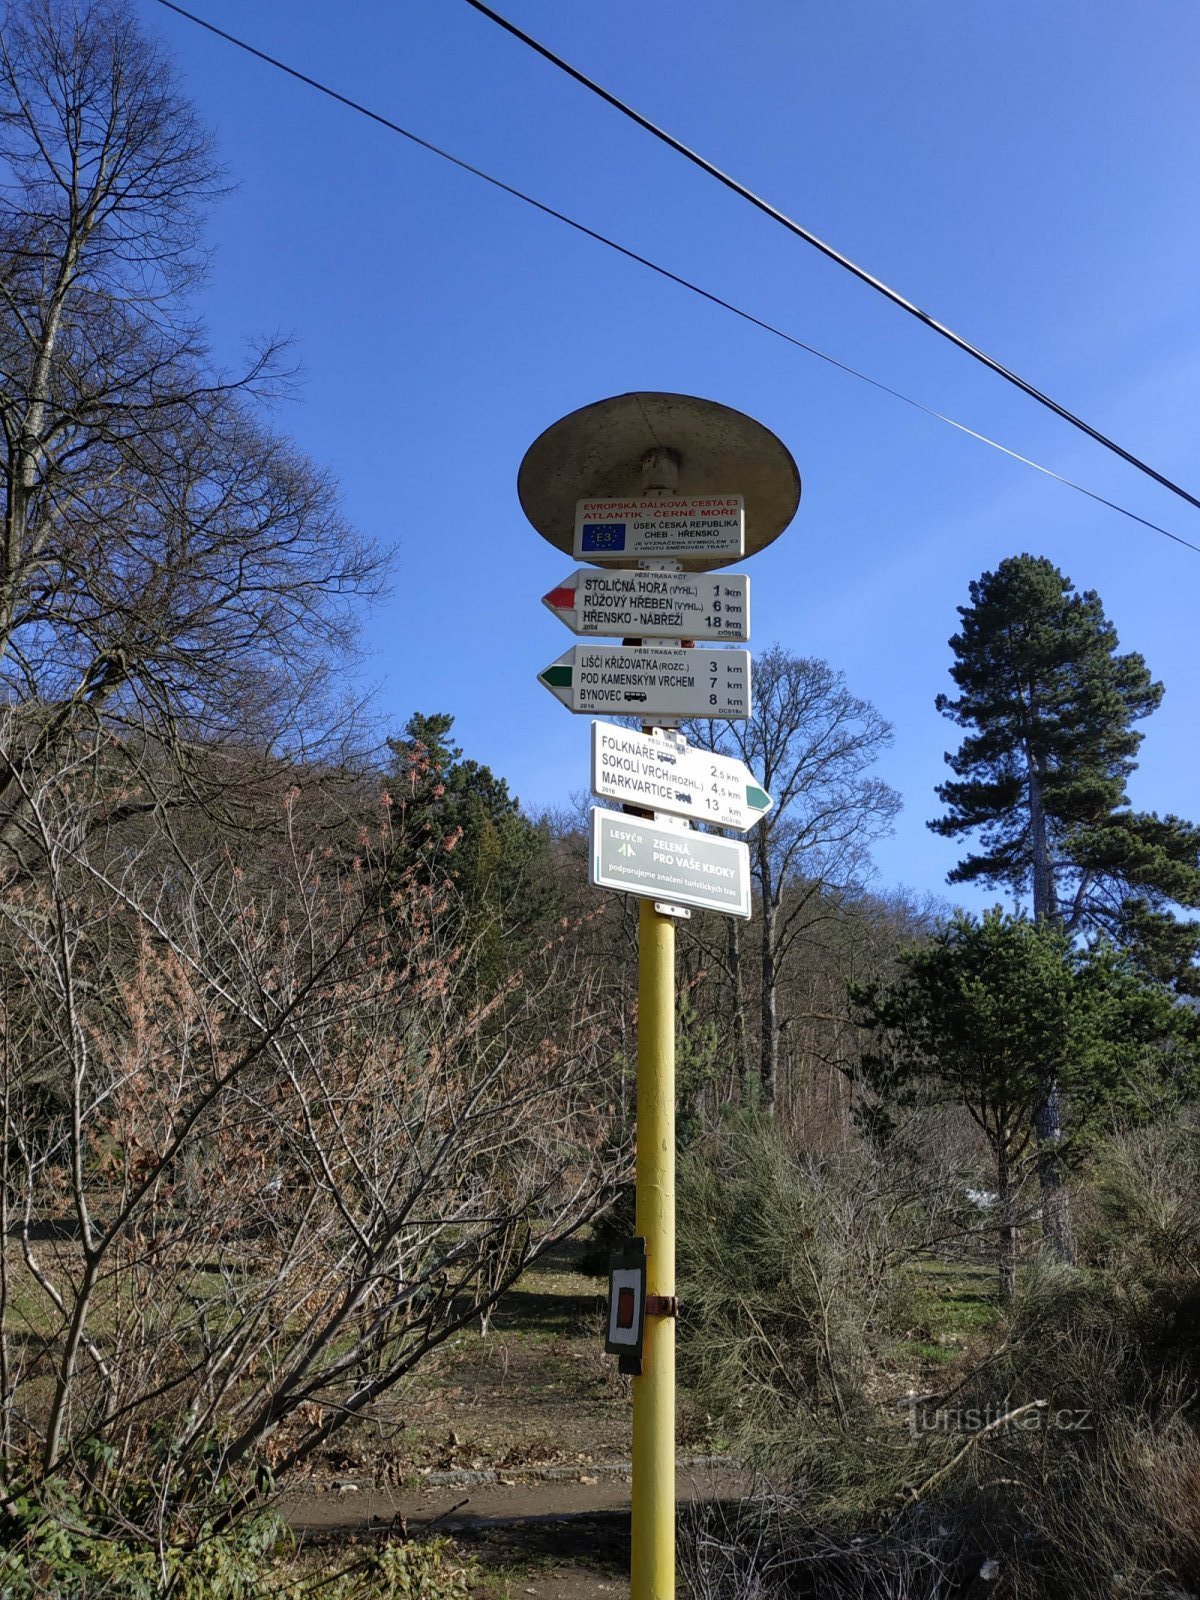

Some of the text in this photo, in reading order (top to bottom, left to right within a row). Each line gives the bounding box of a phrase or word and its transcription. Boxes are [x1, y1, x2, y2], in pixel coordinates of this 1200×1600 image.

[584, 502, 636, 510] EVROPSKÁ
[640, 500, 688, 508] DÁLKOVÁ
[654, 509, 696, 517] ČERNÉ
[701, 508, 736, 516] MOŘE
[634, 521, 656, 529] ÚSEK
[659, 520, 687, 528] ČESKÁ
[597, 533, 611, 541] E3
[585, 578, 741, 597] STOLIČNÁ HORA (VYHL.) 1 km
[584, 593, 742, 612] RŮŽOVÝ HŘEBEN (VYHL.) 6 km
[583, 610, 631, 623] HŘENSKO
[640, 612, 683, 626] NÁBŘEŽÍ
[705, 616, 721, 627] 18
[725, 620, 742, 629] km
[582, 655, 603, 668] LIŠČÍ
[605, 655, 658, 670] KŘIŽOVATKA
[659, 663, 689, 672] (ROZC.)
[710, 661, 718, 672] 3
[581, 673, 598, 684] POD
[601, 673, 656, 686] KAMENSKÝM
[658, 676, 694, 687] VRCHEM
[710, 678, 718, 688] 7
[580, 689, 742, 706] BYNOVEC 8 km
[602, 735, 739, 782] FOLKNÁŘE 2,5 km
[602, 752, 639, 773] SOKOLÍ
[642, 764, 668, 781] VRCH
[711, 784, 725, 797] 4,5
[728, 790, 740, 799] km
[602, 786, 616, 794] 2016
[602, 771, 741, 817] MARKVARTICE 13 km
[653, 839, 690, 855] ZELENÁ
[653, 852, 735, 878] PRO VAŠE KROKY
[609, 863, 736, 896] podporujeme značení turistických tras
